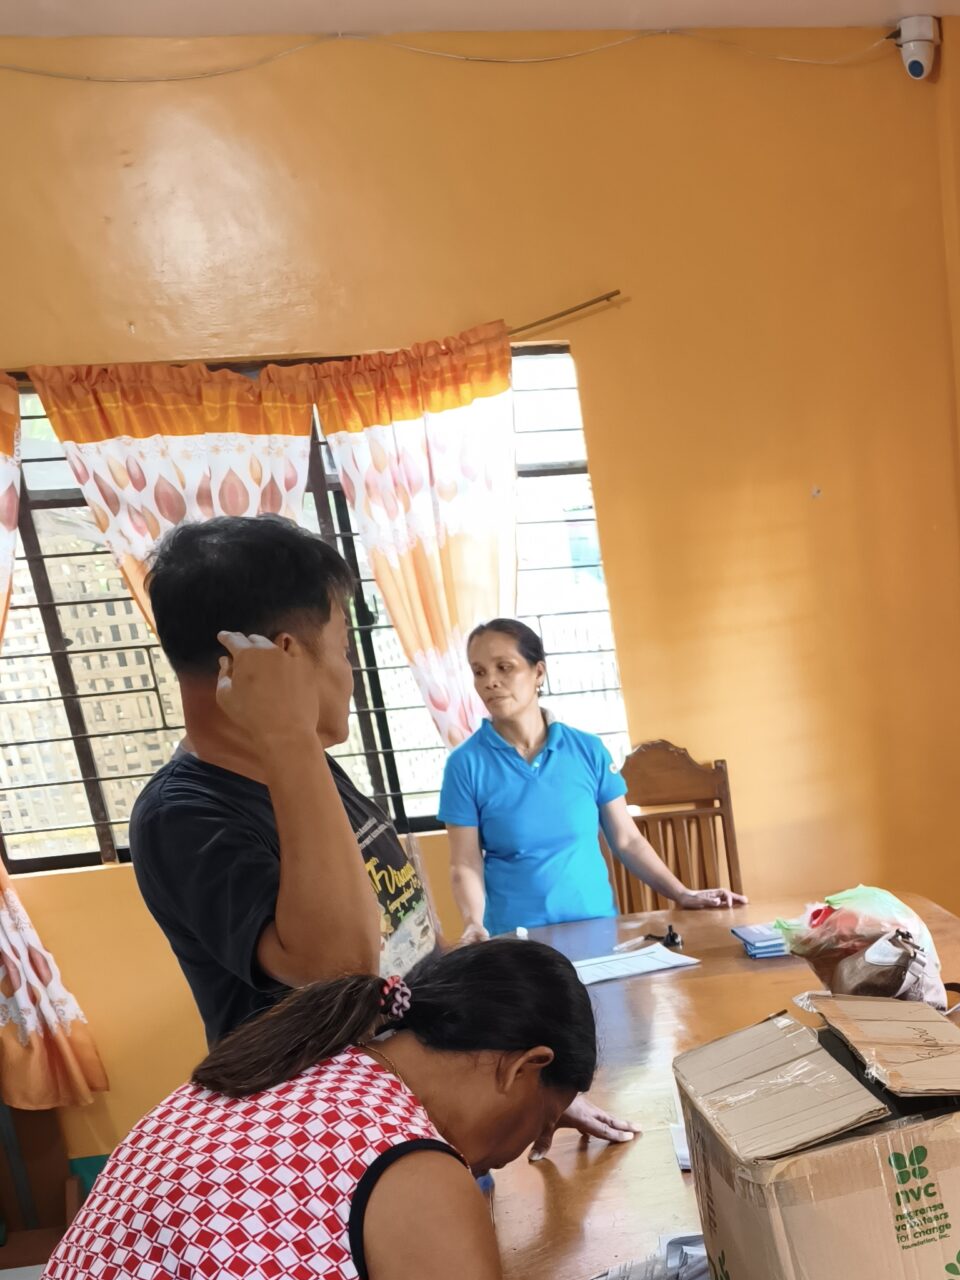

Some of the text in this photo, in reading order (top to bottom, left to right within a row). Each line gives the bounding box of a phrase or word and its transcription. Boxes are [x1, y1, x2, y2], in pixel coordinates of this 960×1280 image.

[895, 1183, 937, 1206] nvc
[895, 1203, 944, 1222] negrense
[895, 1211, 949, 1233] volunteers
[896, 1222, 952, 1244] for change
